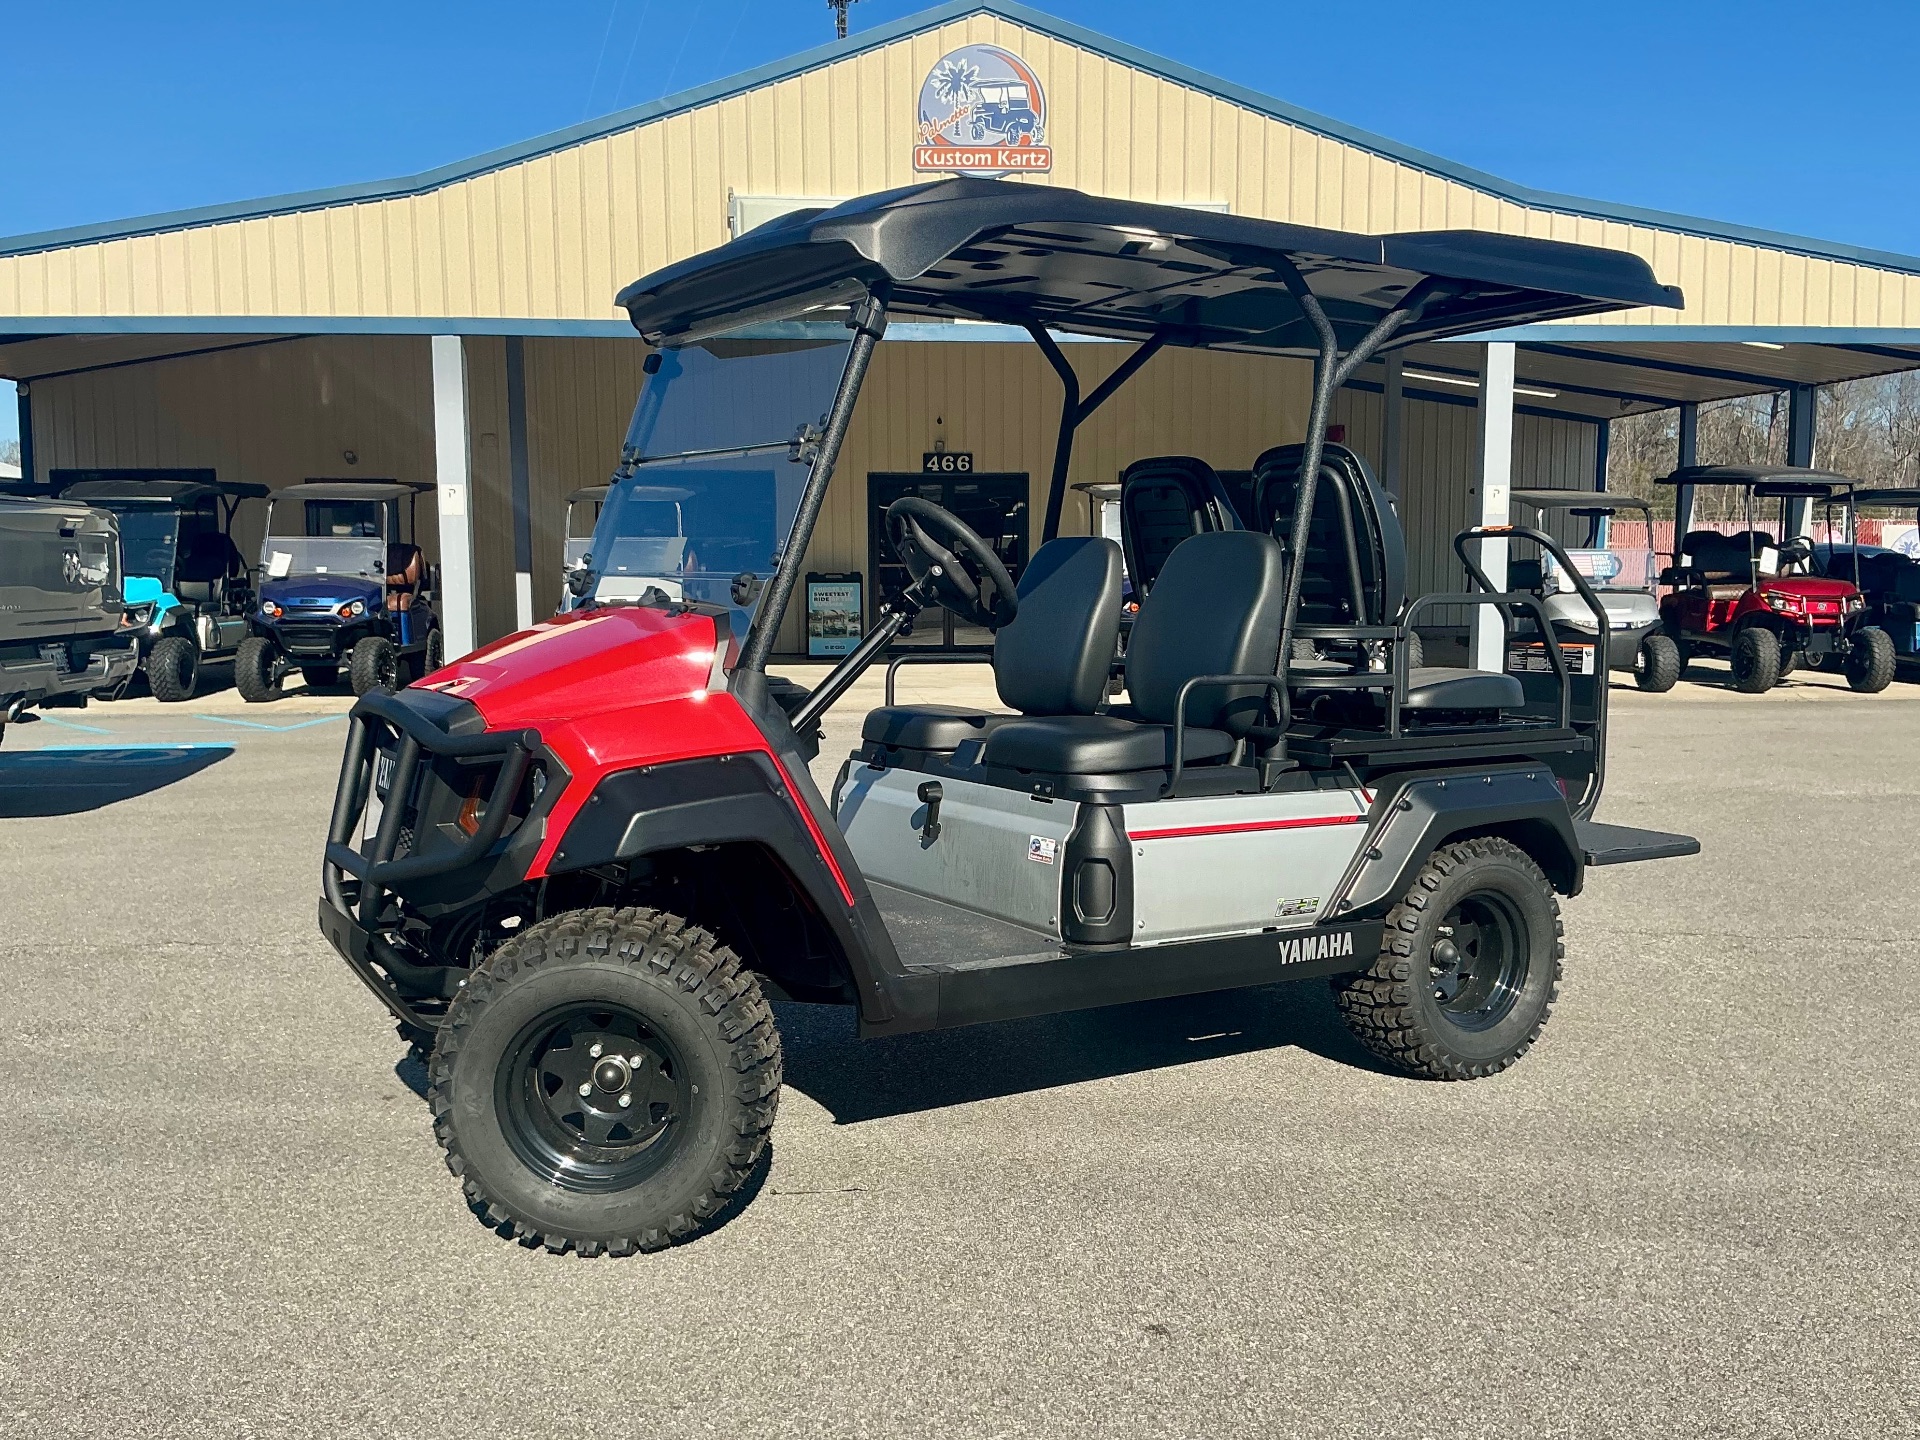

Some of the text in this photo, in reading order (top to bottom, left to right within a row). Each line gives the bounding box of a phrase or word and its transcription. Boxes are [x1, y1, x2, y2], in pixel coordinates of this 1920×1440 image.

[918, 105, 970, 143] Palmetto
[919, 150, 1047, 166] Kustom Kartz
[926, 455, 970, 472] 466
[1278, 931, 1354, 965] YAMAHA
